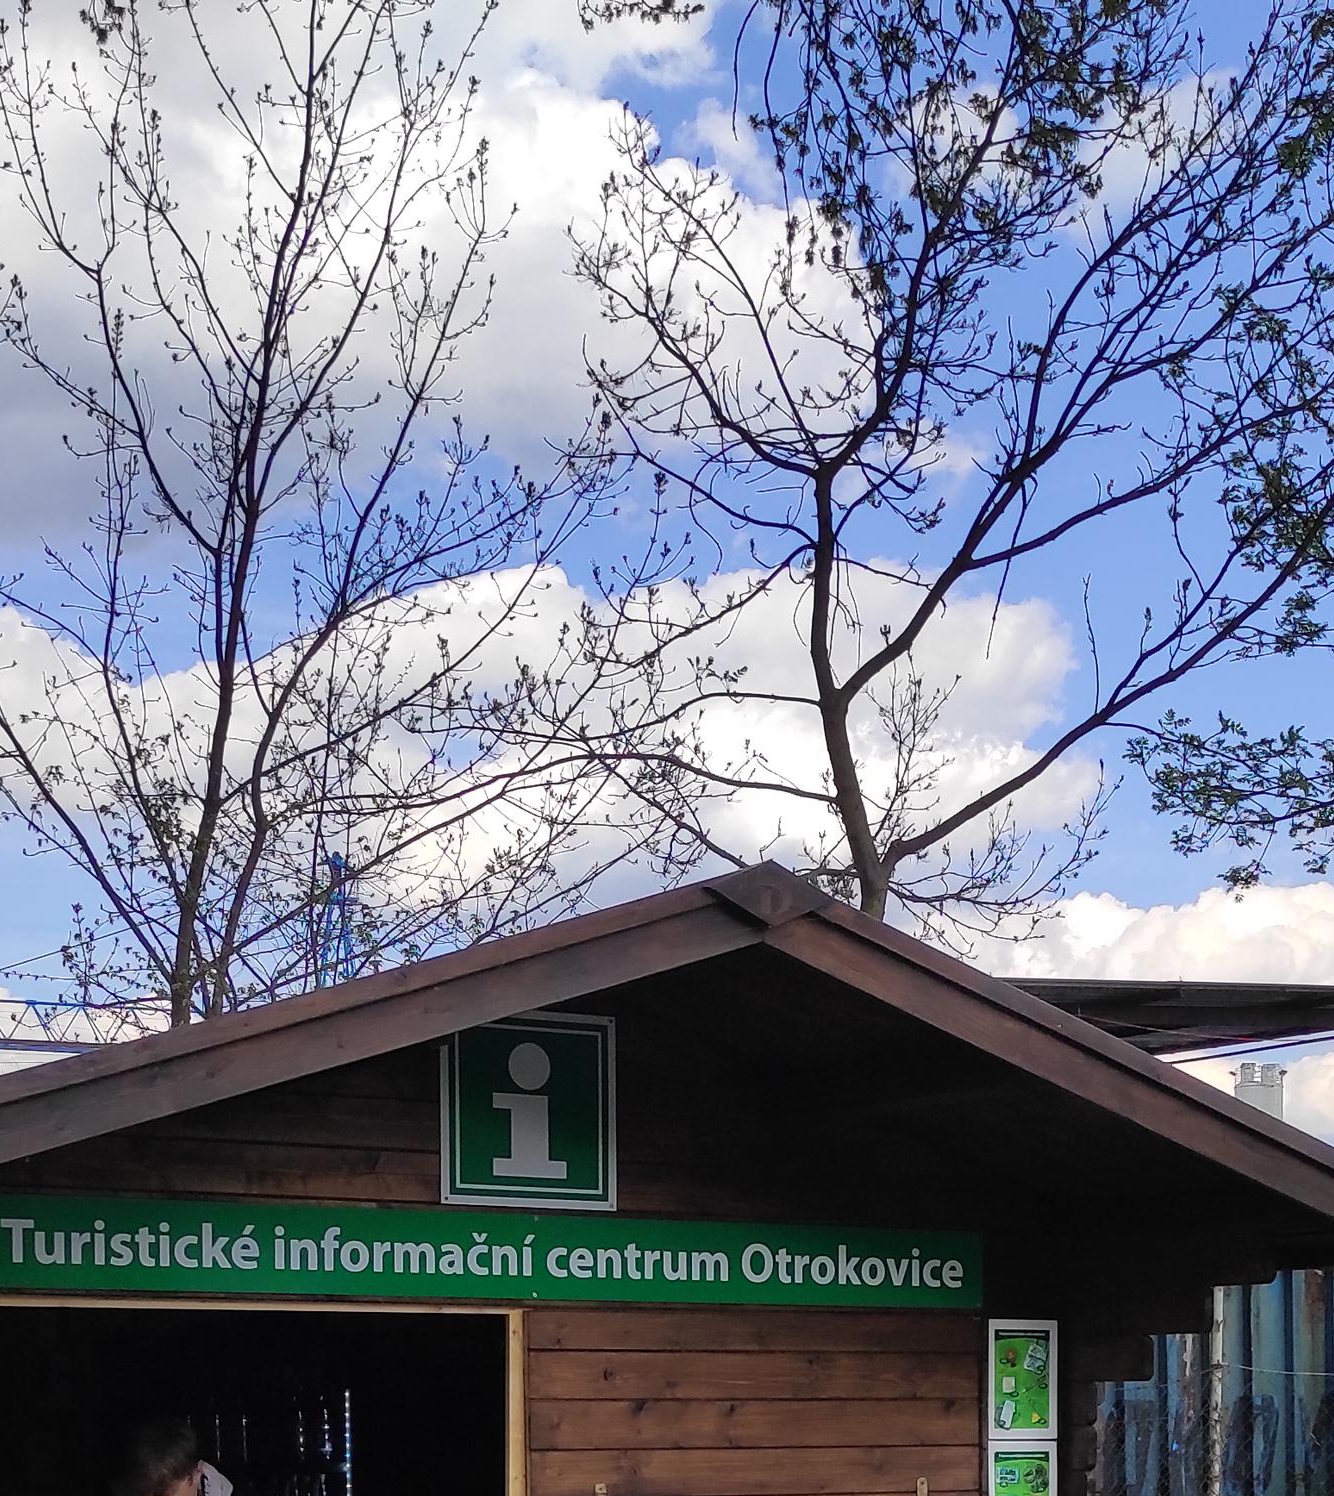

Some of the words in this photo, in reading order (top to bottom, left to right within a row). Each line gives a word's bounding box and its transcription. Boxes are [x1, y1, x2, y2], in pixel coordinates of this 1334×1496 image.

[492, 1042, 567, 1180] i
[0, 1218, 260, 1270] Turistické
[274, 1225, 536, 1277] informační
[546, 1242, 729, 1282] centrum
[741, 1243, 964, 1288] Otrokovice
